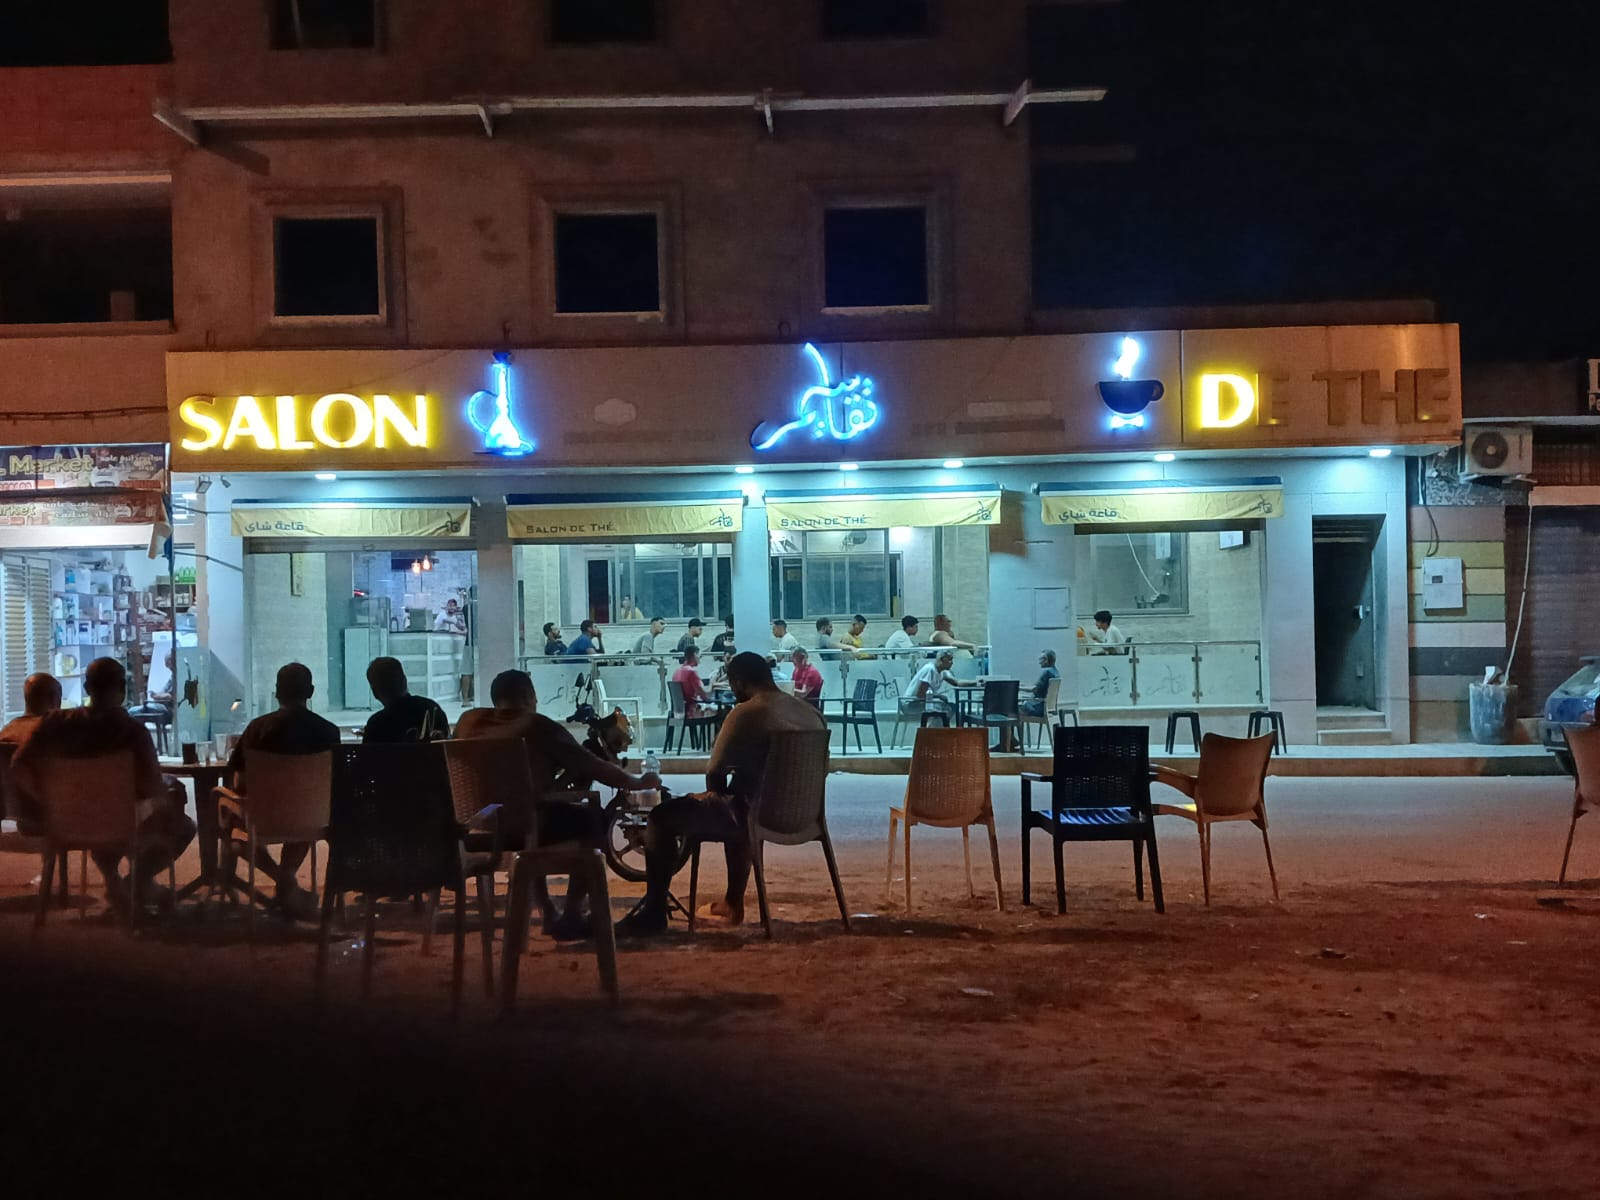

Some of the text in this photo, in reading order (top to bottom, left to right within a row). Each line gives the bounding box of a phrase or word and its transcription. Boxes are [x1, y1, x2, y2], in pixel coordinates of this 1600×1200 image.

[179, 368, 1450, 451] SALON DE THE
[9, 455, 94, 475] Market
[526, 525, 567, 534] SALON
[781, 518, 821, 527] SALON
